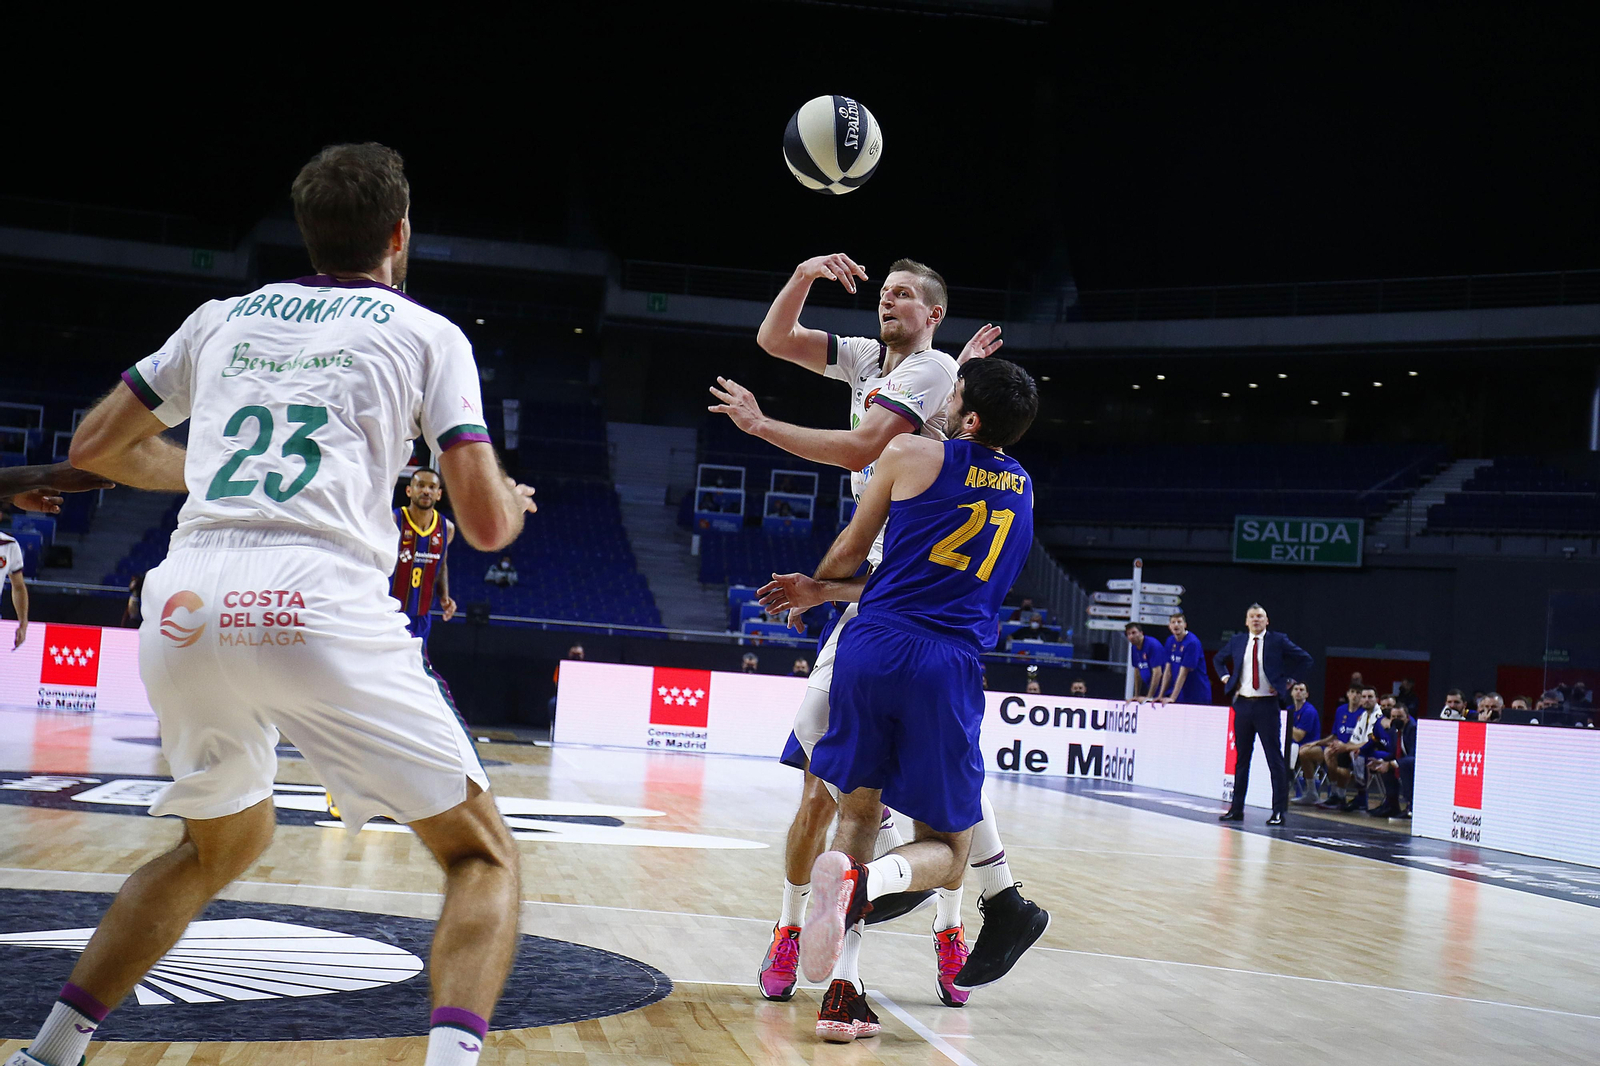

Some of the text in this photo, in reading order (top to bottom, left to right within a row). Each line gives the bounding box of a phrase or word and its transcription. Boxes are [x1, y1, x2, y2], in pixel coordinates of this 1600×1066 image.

[226, 294, 395, 324] ABROMAITIS
[205, 404, 328, 502] 23
[964, 465, 1026, 494] ABRINES
[928, 500, 1016, 582] 21
[1242, 521, 1351, 544] SALIDA
[1271, 544, 1320, 561] EXIT
[411, 567, 422, 588] 8
[223, 590, 306, 609] COSTA
[219, 611, 305, 628] DEL SOL
[219, 629, 306, 647] MÁLAGA
[38, 687, 97, 699] Comunidad
[37, 698, 96, 711] de Madrid
[1000, 696, 1139, 734] Comunidad
[648, 728, 708, 740] Comunidad
[647, 738, 707, 750] de Madrid
[997, 740, 1135, 782] de Madrid
[1452, 811, 1482, 827] Comunidad
[1452, 826, 1481, 843] de Madrid
